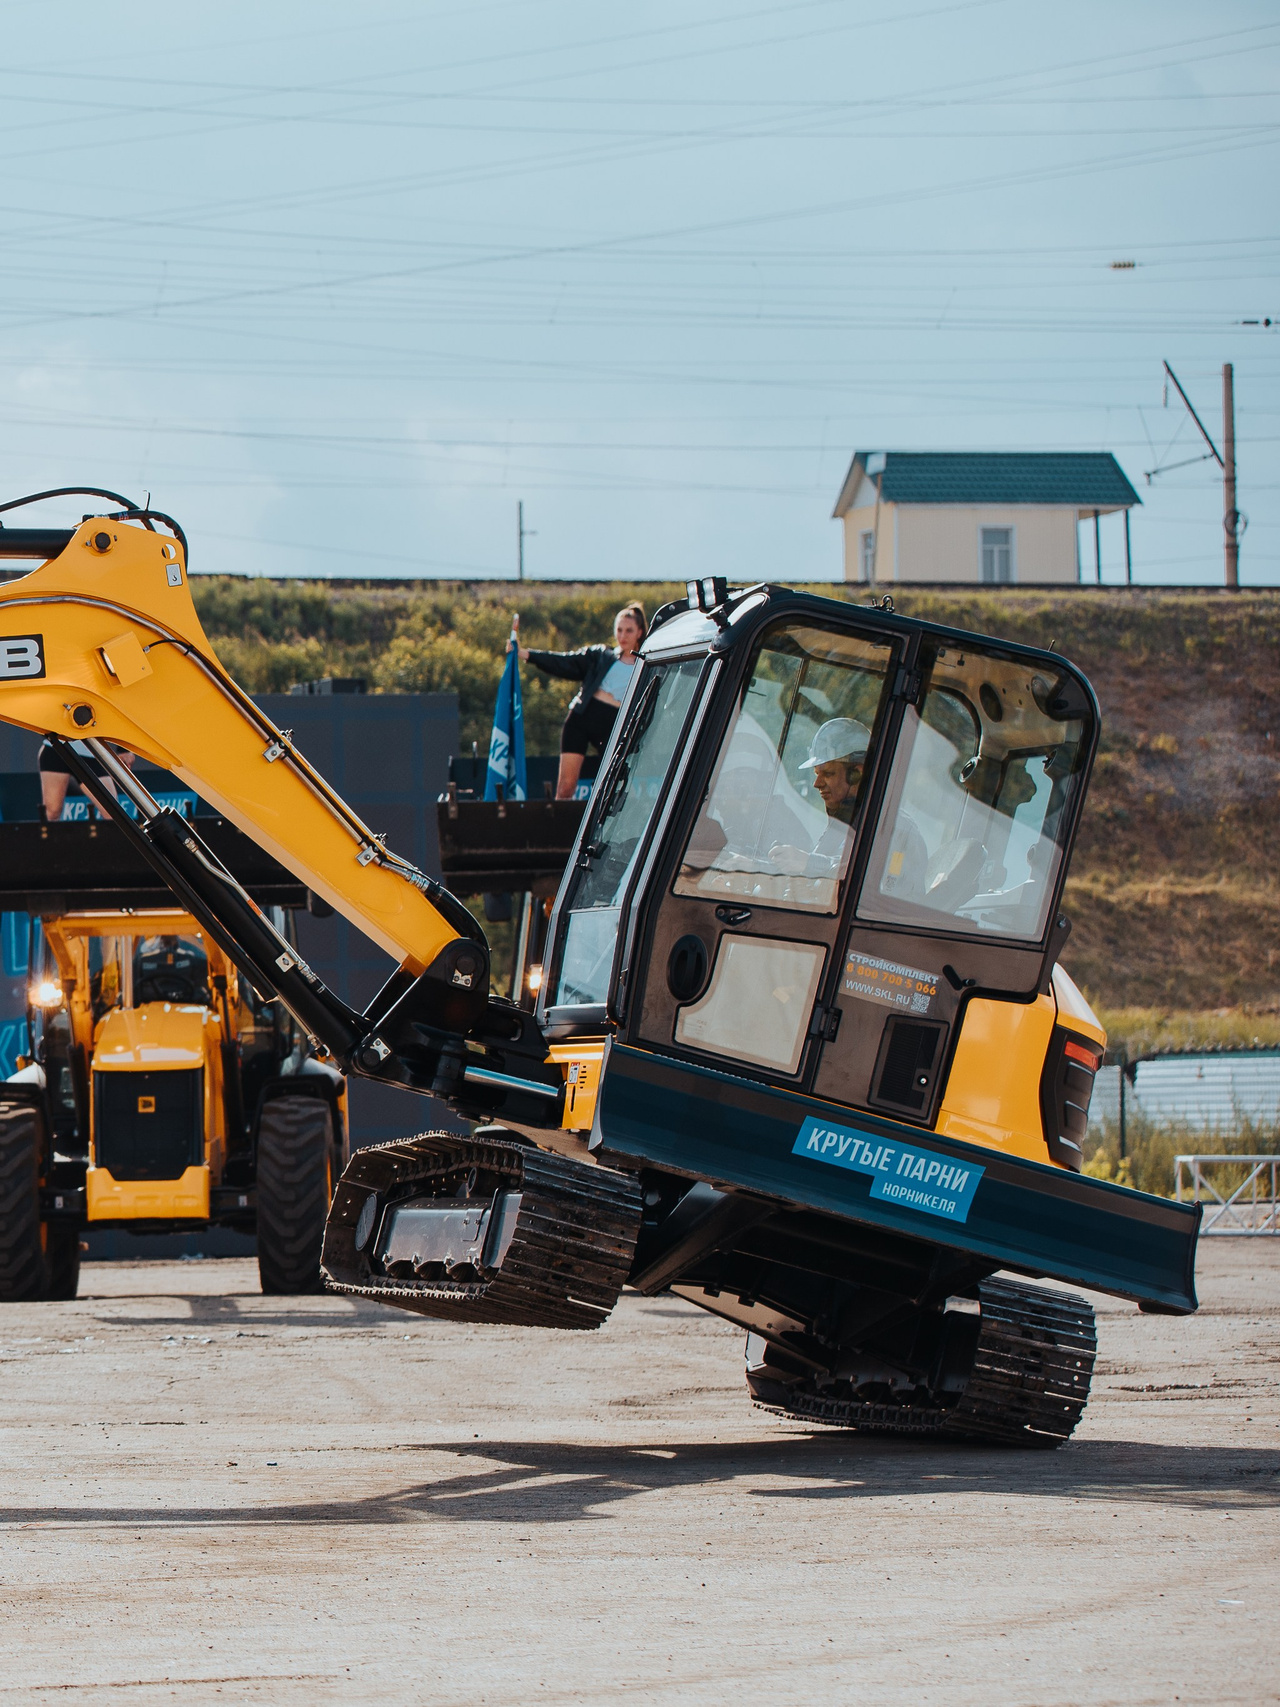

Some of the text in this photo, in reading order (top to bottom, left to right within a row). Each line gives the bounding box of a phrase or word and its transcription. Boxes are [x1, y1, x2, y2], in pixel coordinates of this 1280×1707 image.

[849, 953, 939, 984] СТРОЙКОМПЛЕКТ
[857, 965, 878, 979] 800
[882, 971, 902, 986] 700
[915, 982, 936, 996] 066
[845, 979, 910, 1005] WWW.SKL.RU
[806, 1127, 970, 1193] КРУТЫЕ ПАРНИ
[882, 1182, 957, 1214] НОРНИКЕЛЯ
